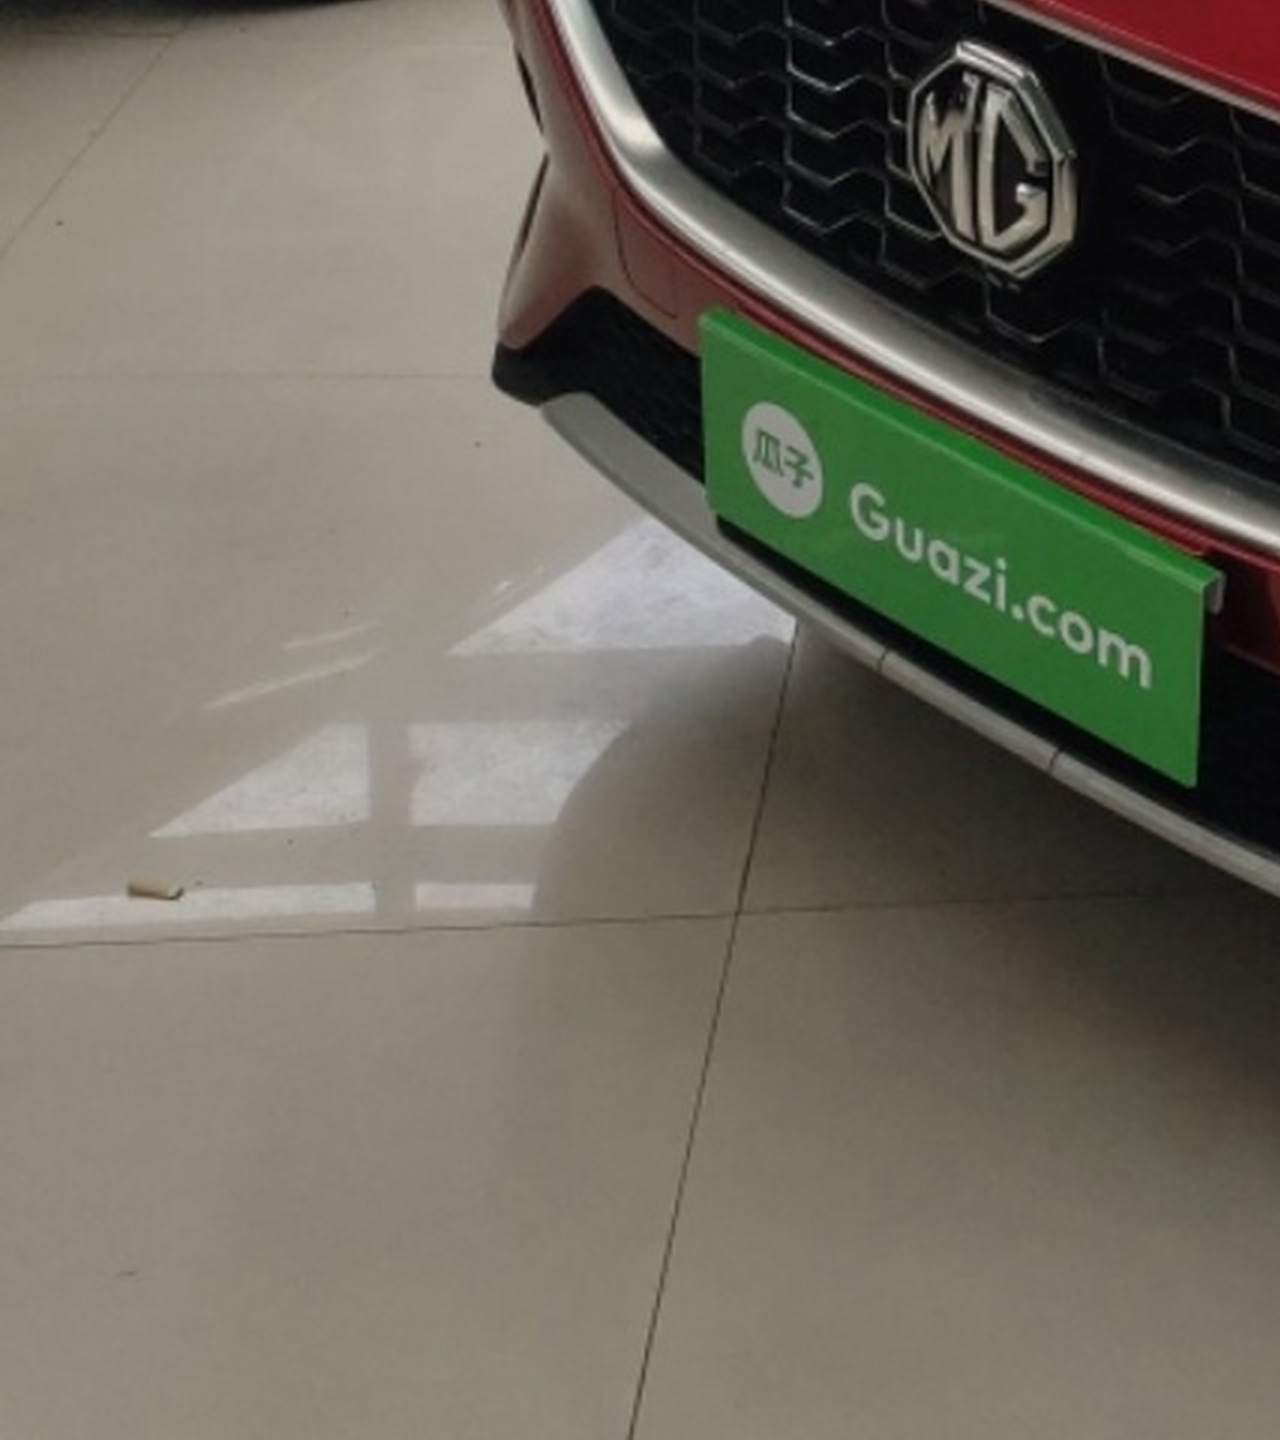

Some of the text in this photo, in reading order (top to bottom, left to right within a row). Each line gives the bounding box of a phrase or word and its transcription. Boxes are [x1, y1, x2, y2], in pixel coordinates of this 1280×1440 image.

[918, 71, 1049, 252] MG
[752, 430, 815, 488] 瓜子
[849, 482, 1152, 689] Guazi.com
